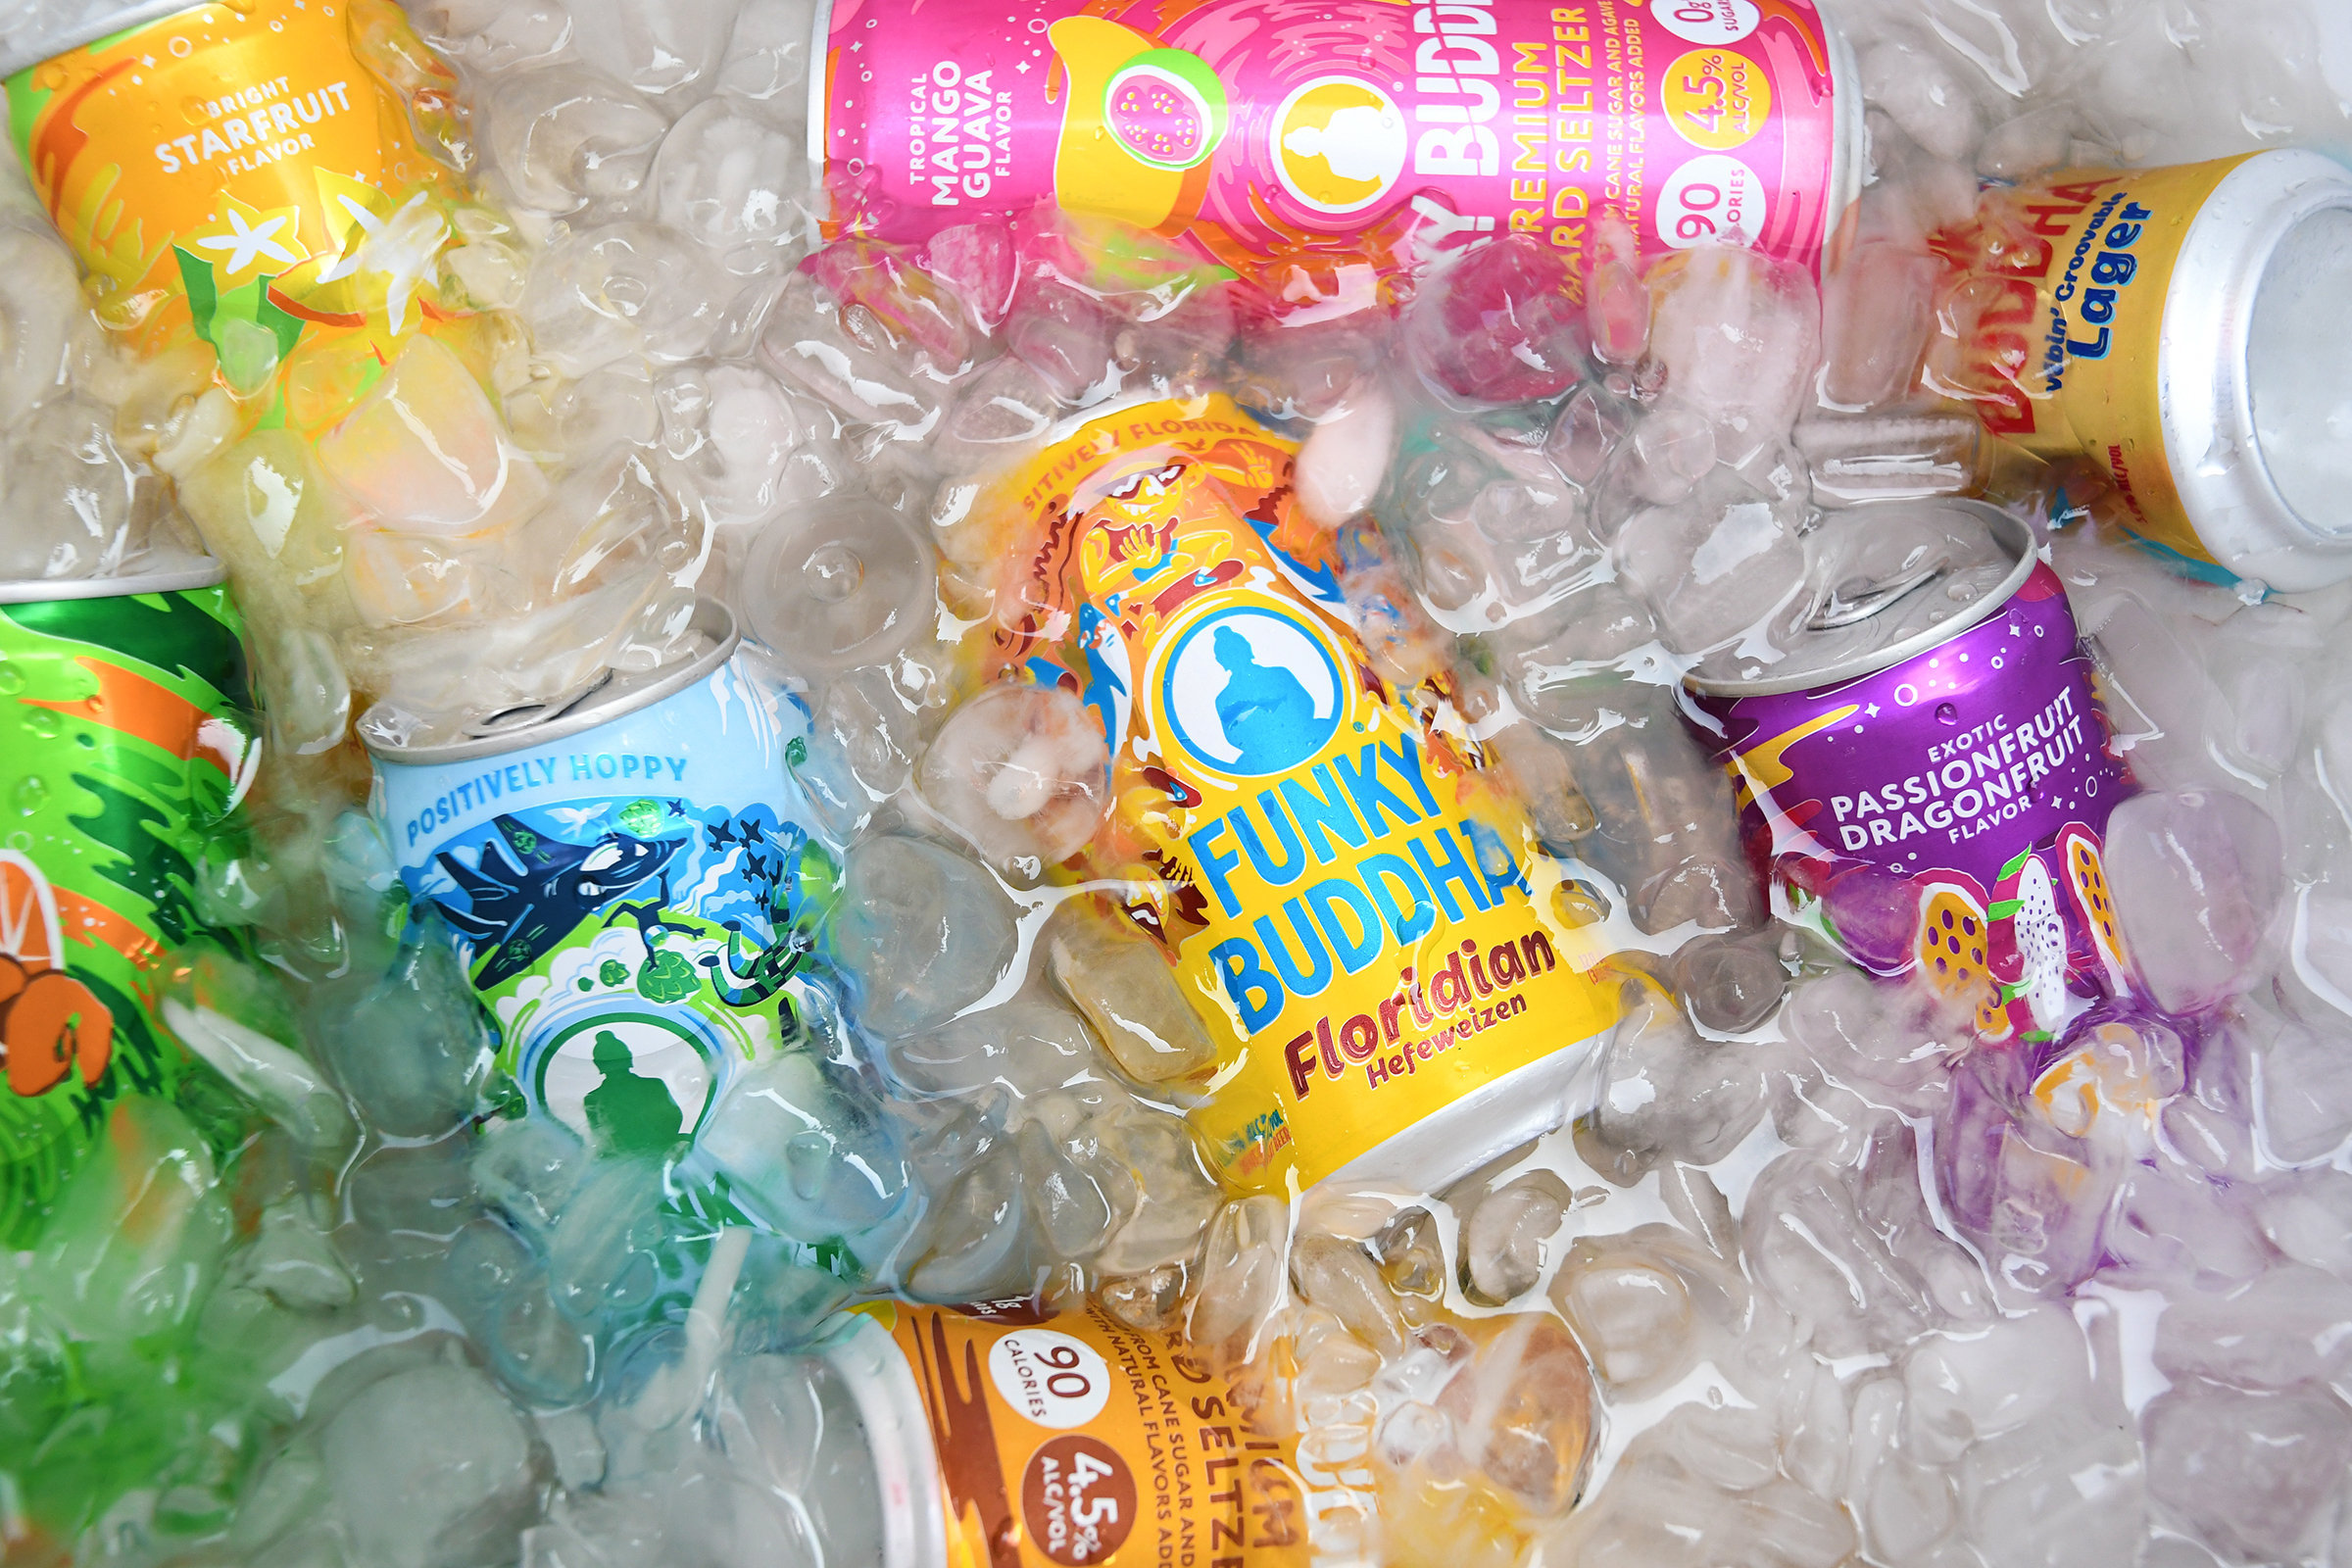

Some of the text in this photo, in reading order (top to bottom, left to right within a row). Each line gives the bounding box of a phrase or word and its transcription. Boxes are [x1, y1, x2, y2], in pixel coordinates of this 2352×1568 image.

[1410, 0, 1500, 176] BUDD
[1550, 7, 1594, 173] SELTZER
[1623, 18, 1644, 69] ADDED
[155, 81, 351, 173] STARFRUIT
[206, 76, 290, 119] BRIGHT
[909, 73, 927, 185] TROPICAL
[931, 61, 961, 206] MANGO
[962, 70, 993, 198] GUAVA
[995, 91, 1012, 176] FLAVOR
[1508, 42, 1550, 233] REMIUM
[1596, 0, 1625, 200] CANE SUGAR AND AGAVE
[1628, 71, 1645, 153] FLAVORS
[1683, 54, 1728, 133] 4.5%
[1731, 62, 1752, 135] ALC/VOL
[226, 133, 316, 175] FLAVOR
[1676, 182, 1721, 239] 90
[2055, 192, 2128, 302] Groovable
[2066, 201, 2153, 361] Lager
[1830, 686, 2074, 823] PASSIONFRUIT
[1838, 714, 2083, 852] DRAGONFRUIT
[1927, 713, 2008, 763] EXOTIC
[406, 753, 687, 848] POSITIVELY HOPPY
[1187, 732, 1442, 920] FUNKY
[1947, 795, 2033, 845] FLAVOR
[1207, 817, 1536, 1037] BUDDHA
[1283, 930, 1557, 1102] Floridian
[1366, 993, 1528, 1091] Hefeweizen
[1004, 1339, 1047, 1417] CALORIES
[1033, 1346, 1091, 1397] 90
[1152, 1374, 1180, 1427] CANE
[1107, 1335, 1152, 1417] NATURAL
[1144, 1422, 1172, 1521] FLAVORS
[1168, 1433, 1194, 1510] SUGAR
[1067, 1451, 1118, 1560] 4.5%
[1180, 1517, 1195, 1567] AND
